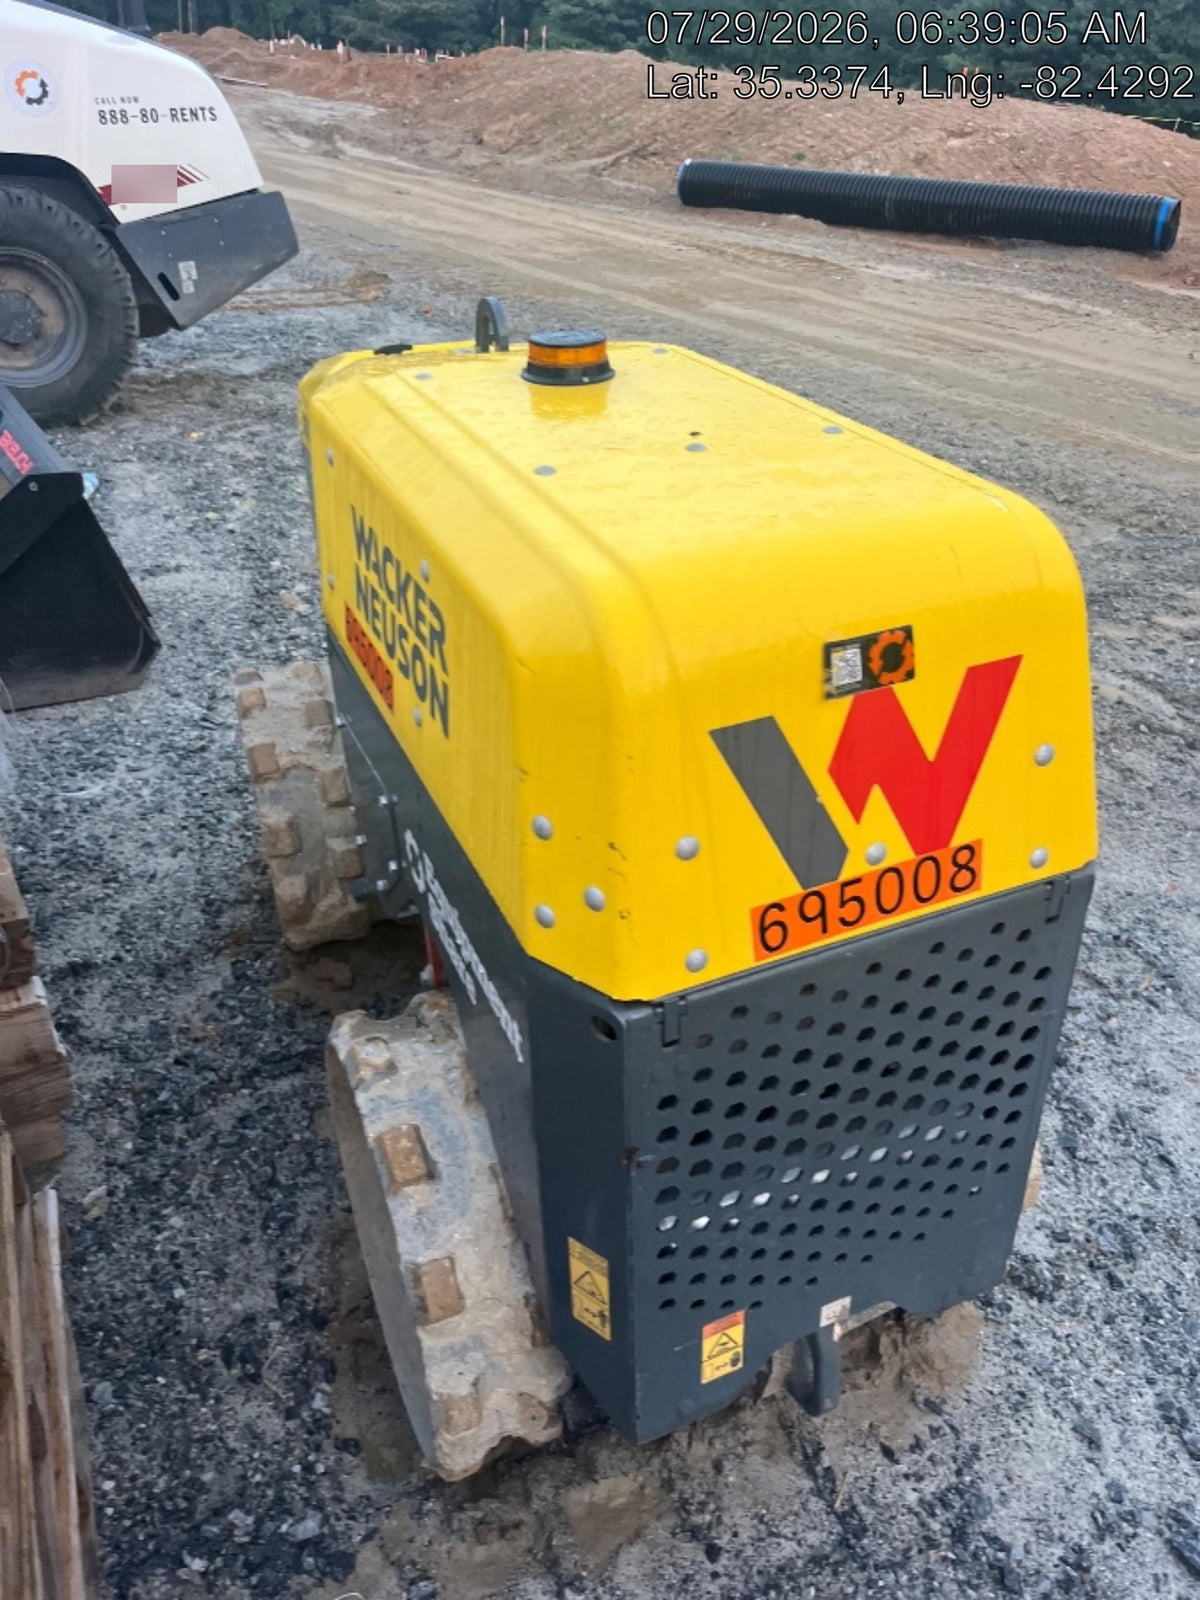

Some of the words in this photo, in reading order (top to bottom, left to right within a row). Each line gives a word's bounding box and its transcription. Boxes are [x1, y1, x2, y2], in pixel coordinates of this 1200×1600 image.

[350, 503, 449, 678] WACKER
[355, 562, 450, 740] NEUSON
[758, 843, 978, 955] 695008
